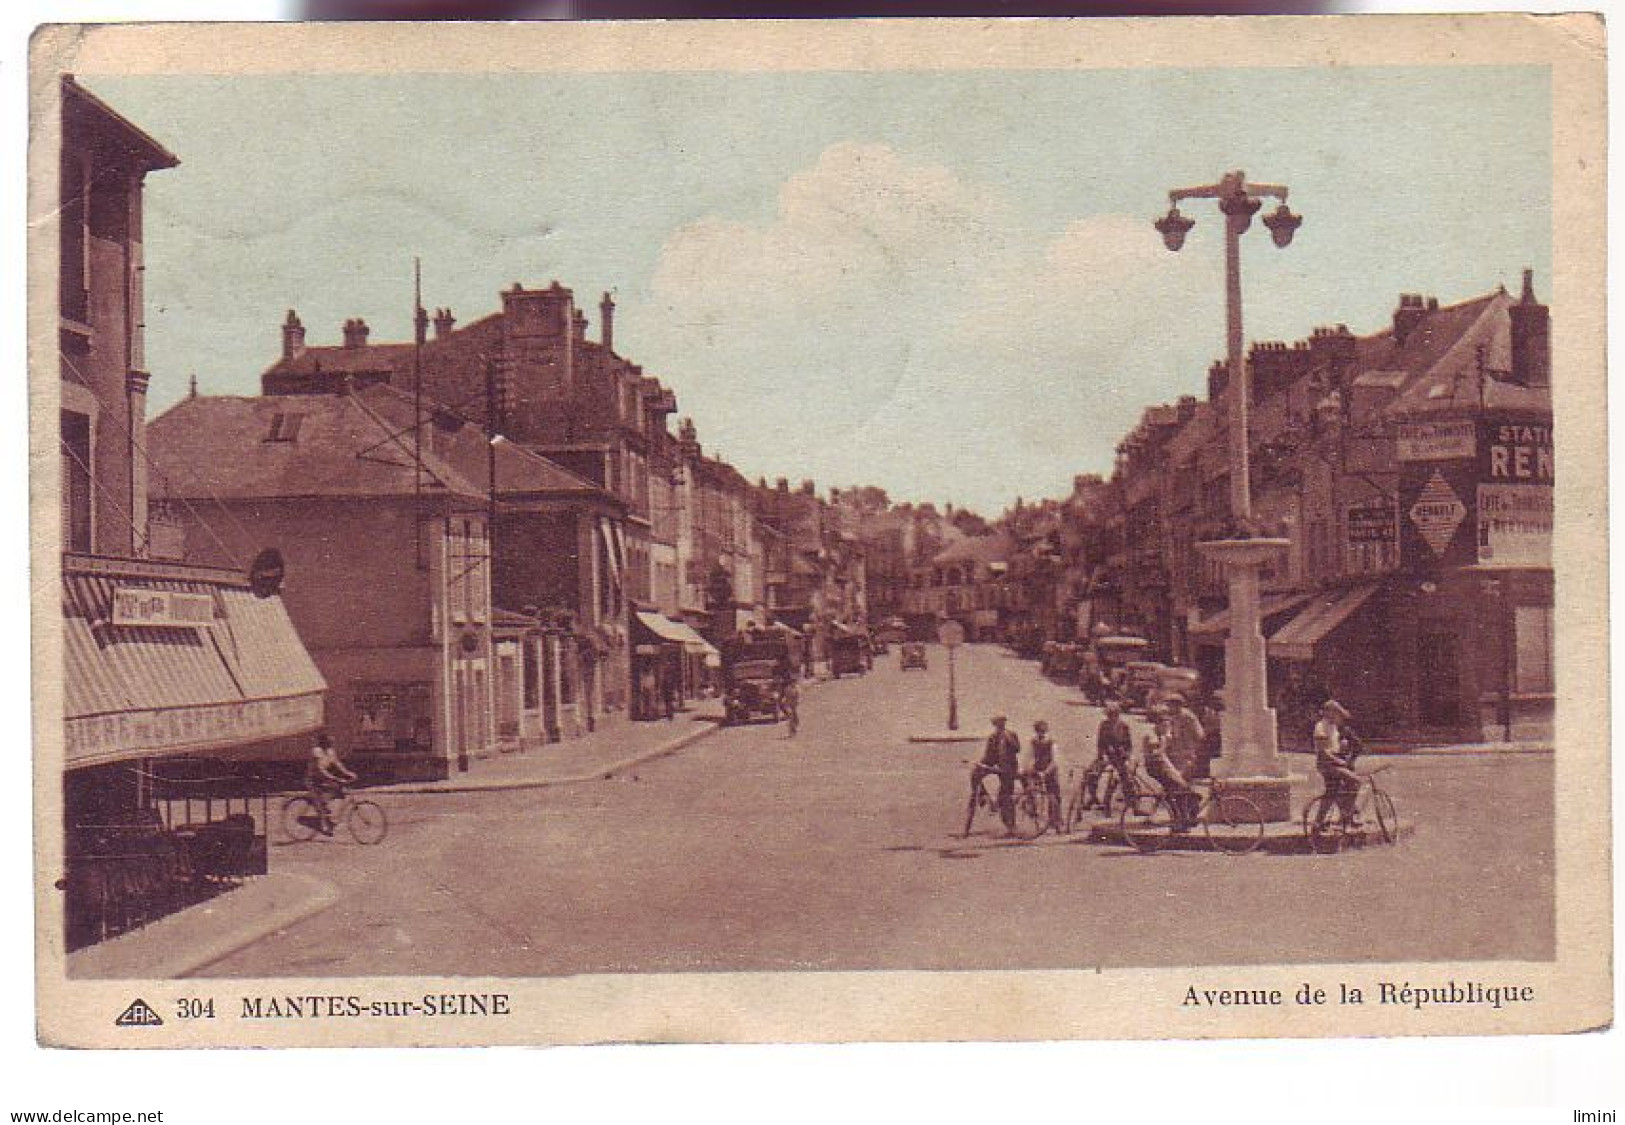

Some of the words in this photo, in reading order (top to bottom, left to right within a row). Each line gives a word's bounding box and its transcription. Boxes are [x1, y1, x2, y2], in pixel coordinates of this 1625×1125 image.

[1499, 426, 1553, 442] STATI
[177, 999, 215, 1018] 304
[242, 995, 509, 1017] MANTES-sur-SEINE
[1184, 987, 1281, 1005] Avenue
[1296, 984, 1325, 1004] de
[1341, 984, 1362, 1003] la
[1379, 982, 1533, 1008] République
